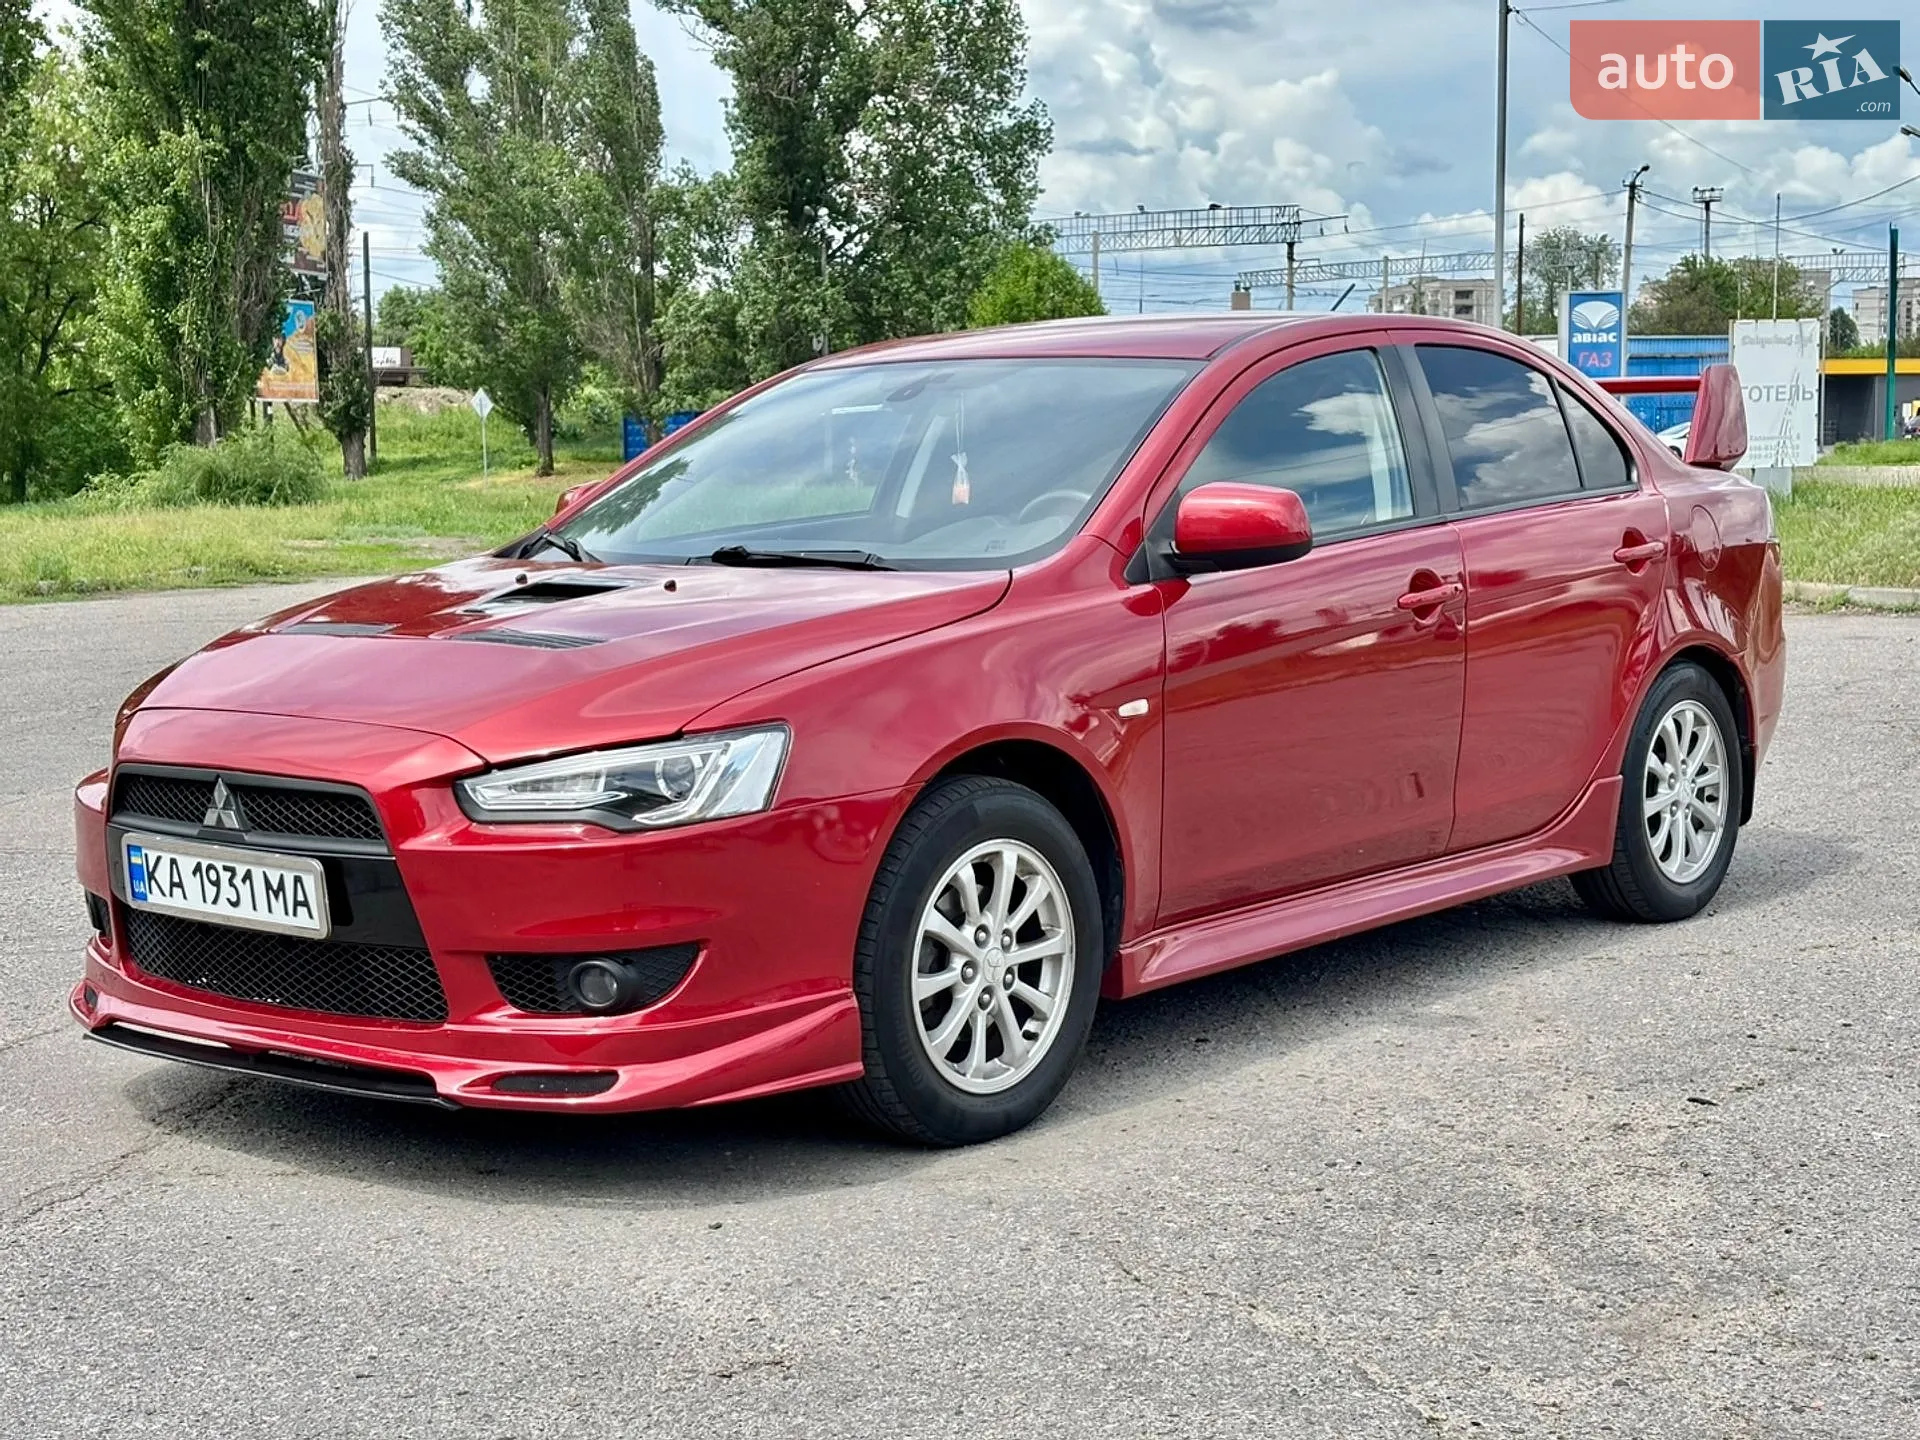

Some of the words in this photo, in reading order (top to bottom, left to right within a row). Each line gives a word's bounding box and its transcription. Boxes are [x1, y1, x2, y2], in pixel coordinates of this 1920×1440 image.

[1578, 351, 1613, 368] ГАЗ
[133, 880, 147, 893] UA
[144, 852, 187, 900] KA
[191, 861, 257, 911] 1931
[263, 870, 314, 920] MA
